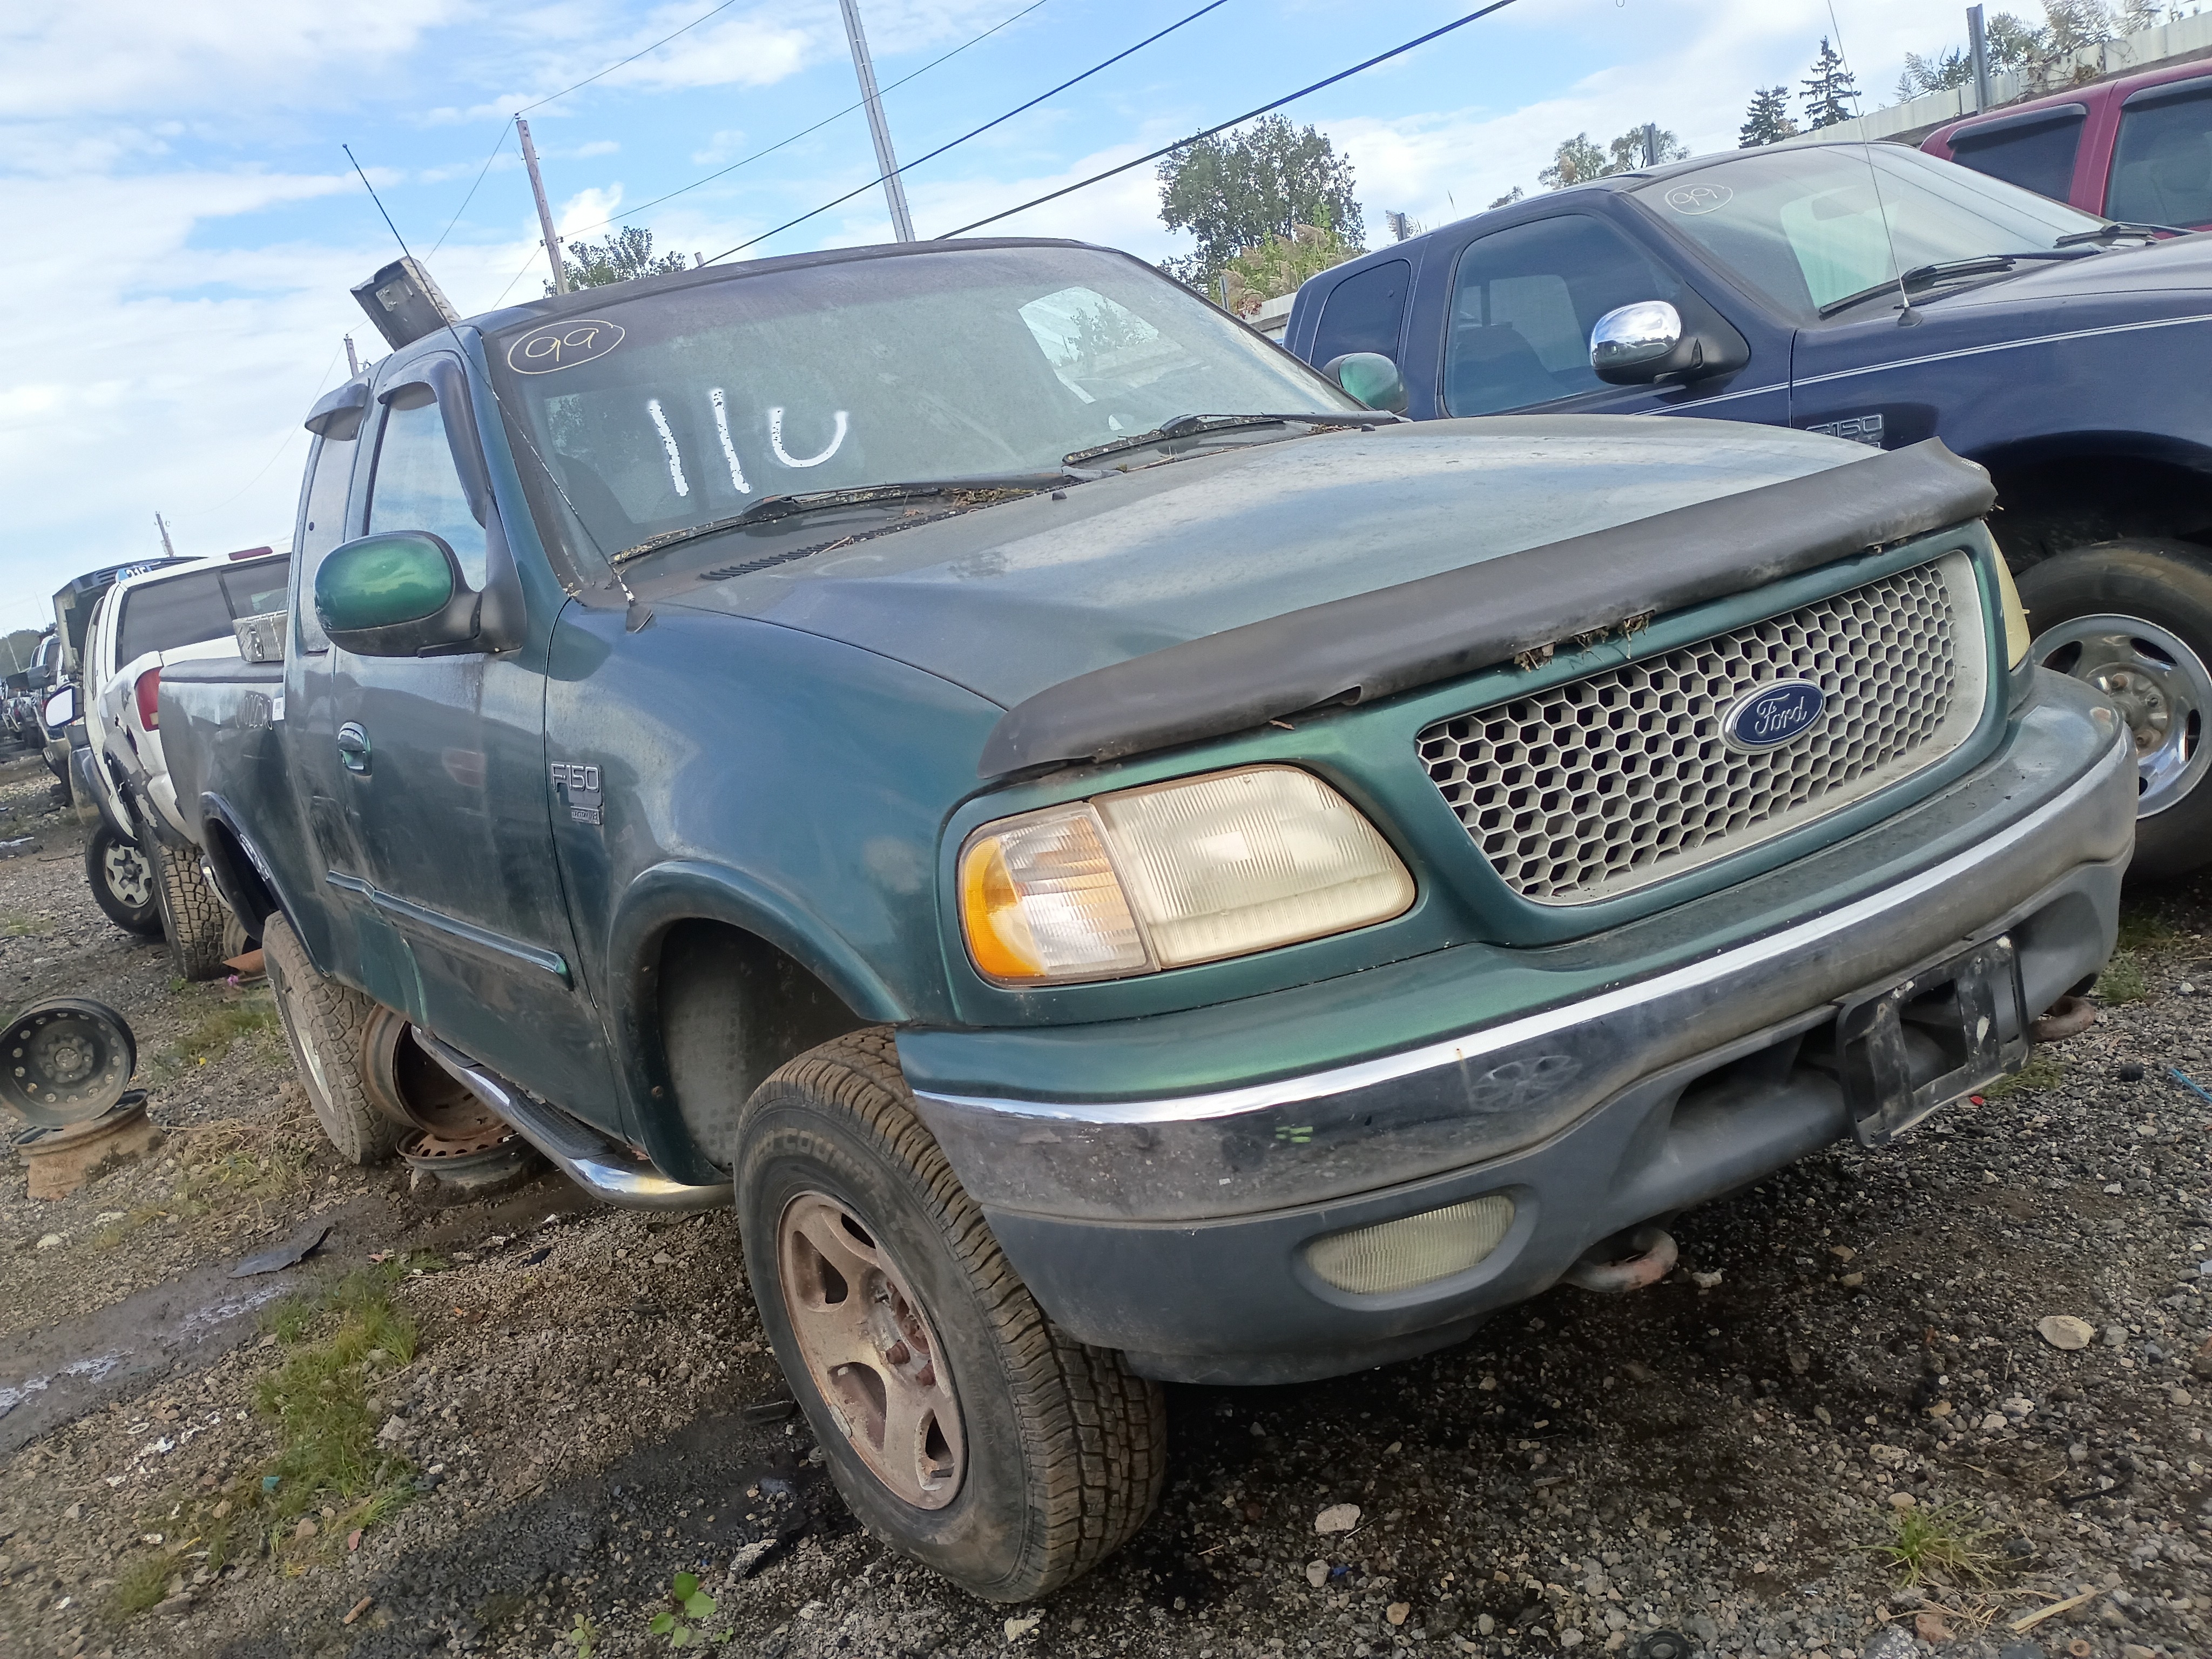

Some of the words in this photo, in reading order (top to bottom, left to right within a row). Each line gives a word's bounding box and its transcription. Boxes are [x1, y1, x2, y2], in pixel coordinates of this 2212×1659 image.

[1673, 187, 1718, 206] 99
[525, 328, 599, 362] 99
[1755, 693, 1808, 734] Ford
[551, 763, 599, 792] F-150
